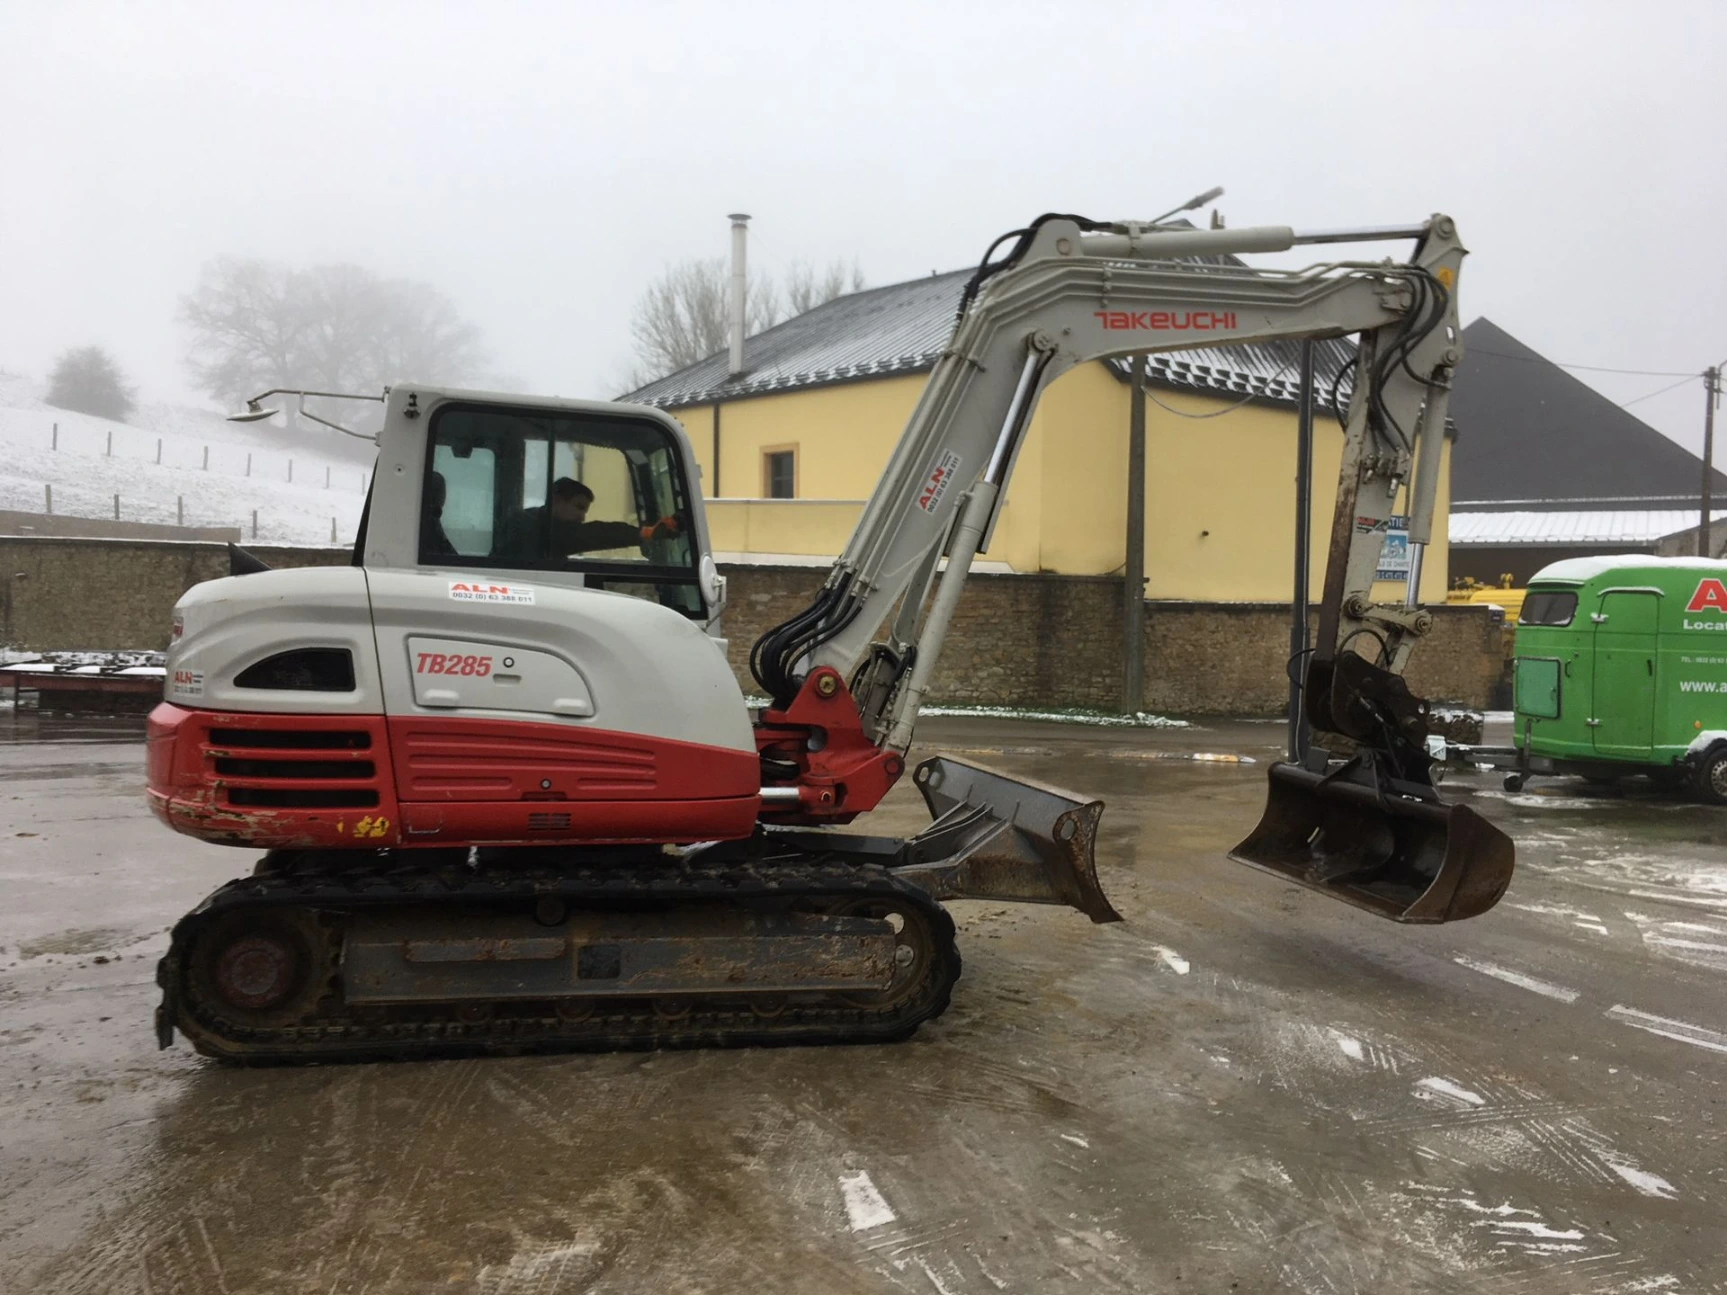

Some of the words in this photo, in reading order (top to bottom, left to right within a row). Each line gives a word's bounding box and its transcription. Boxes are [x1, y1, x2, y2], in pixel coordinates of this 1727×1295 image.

[919, 465, 945, 510] ALN
[452, 583, 509, 594] ALN
[417, 652, 493, 676] TB285
